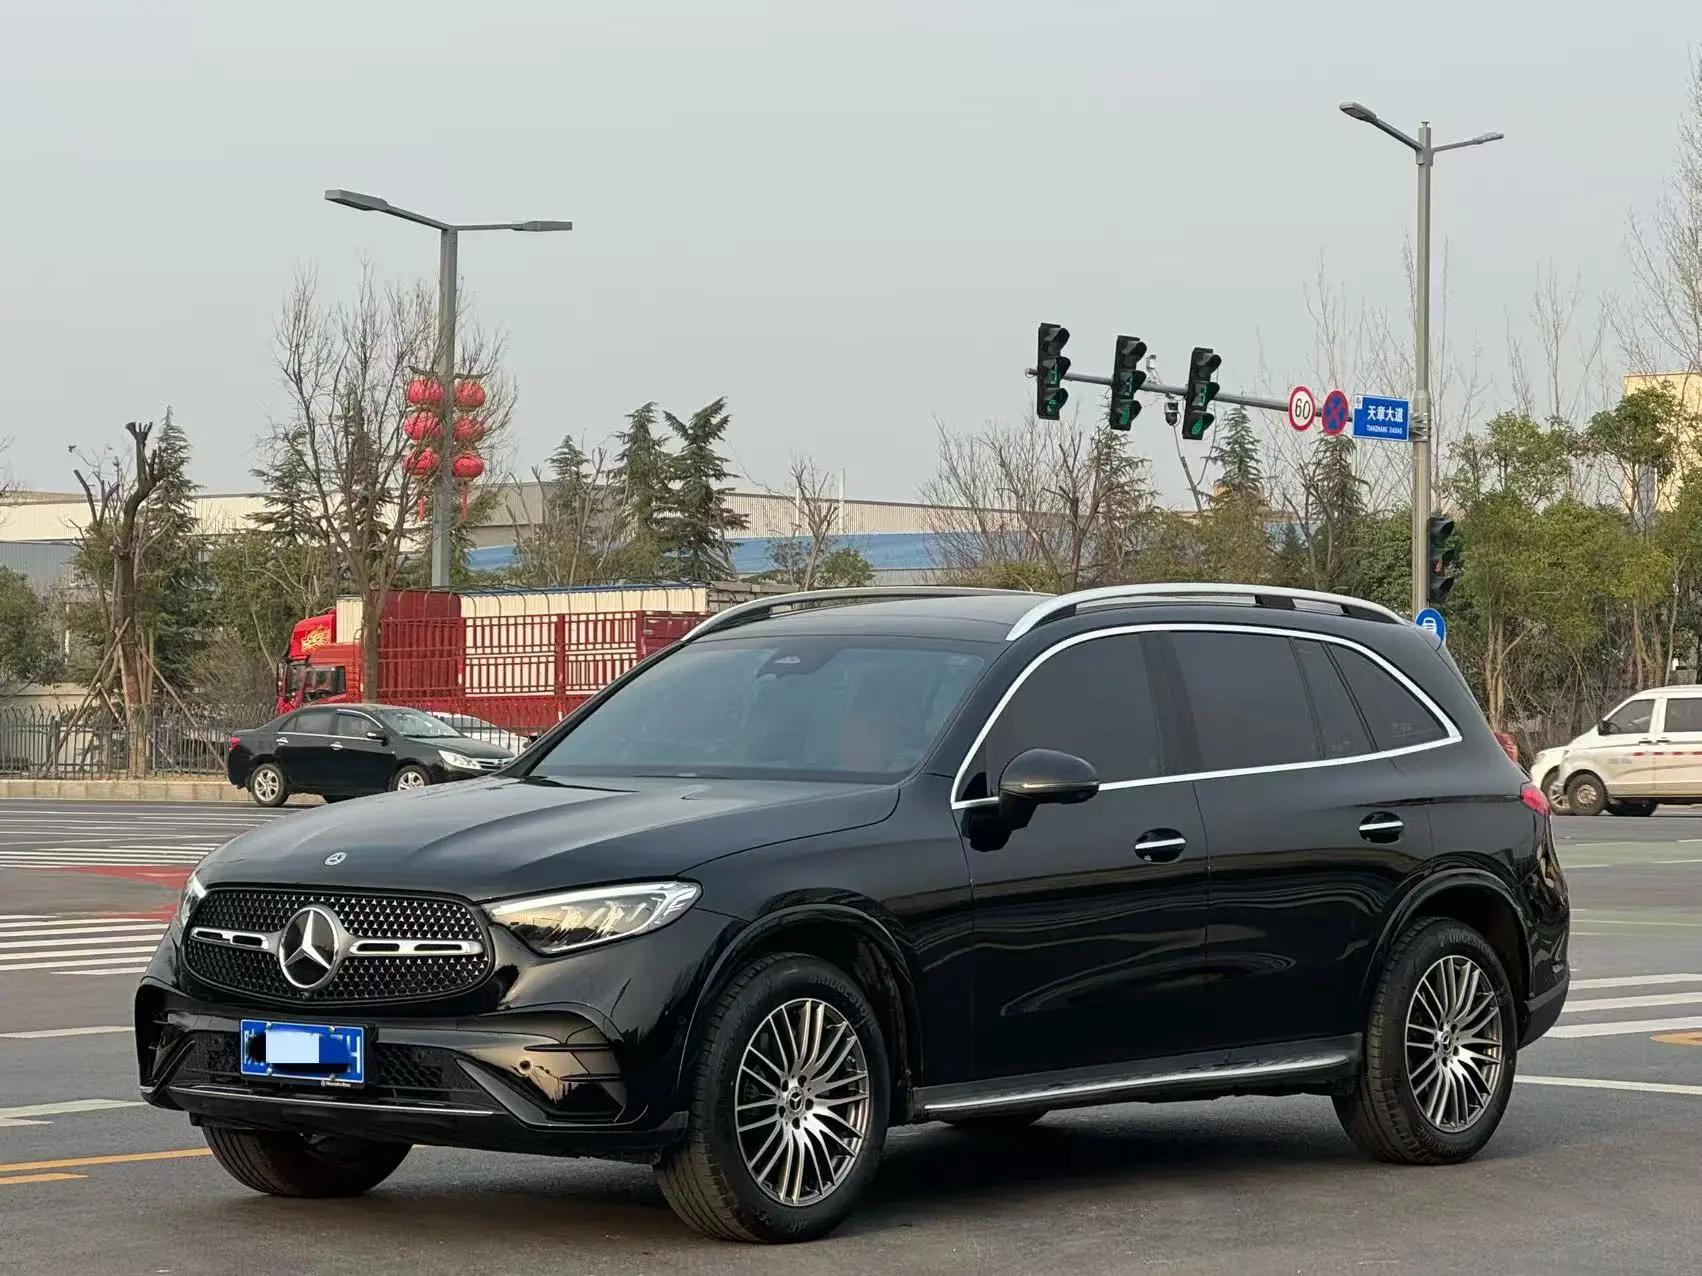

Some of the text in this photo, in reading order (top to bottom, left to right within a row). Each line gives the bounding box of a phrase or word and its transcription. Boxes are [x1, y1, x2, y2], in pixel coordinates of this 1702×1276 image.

[1295, 398, 1310, 419] 60
[1367, 405, 1404, 422] 天章大道
